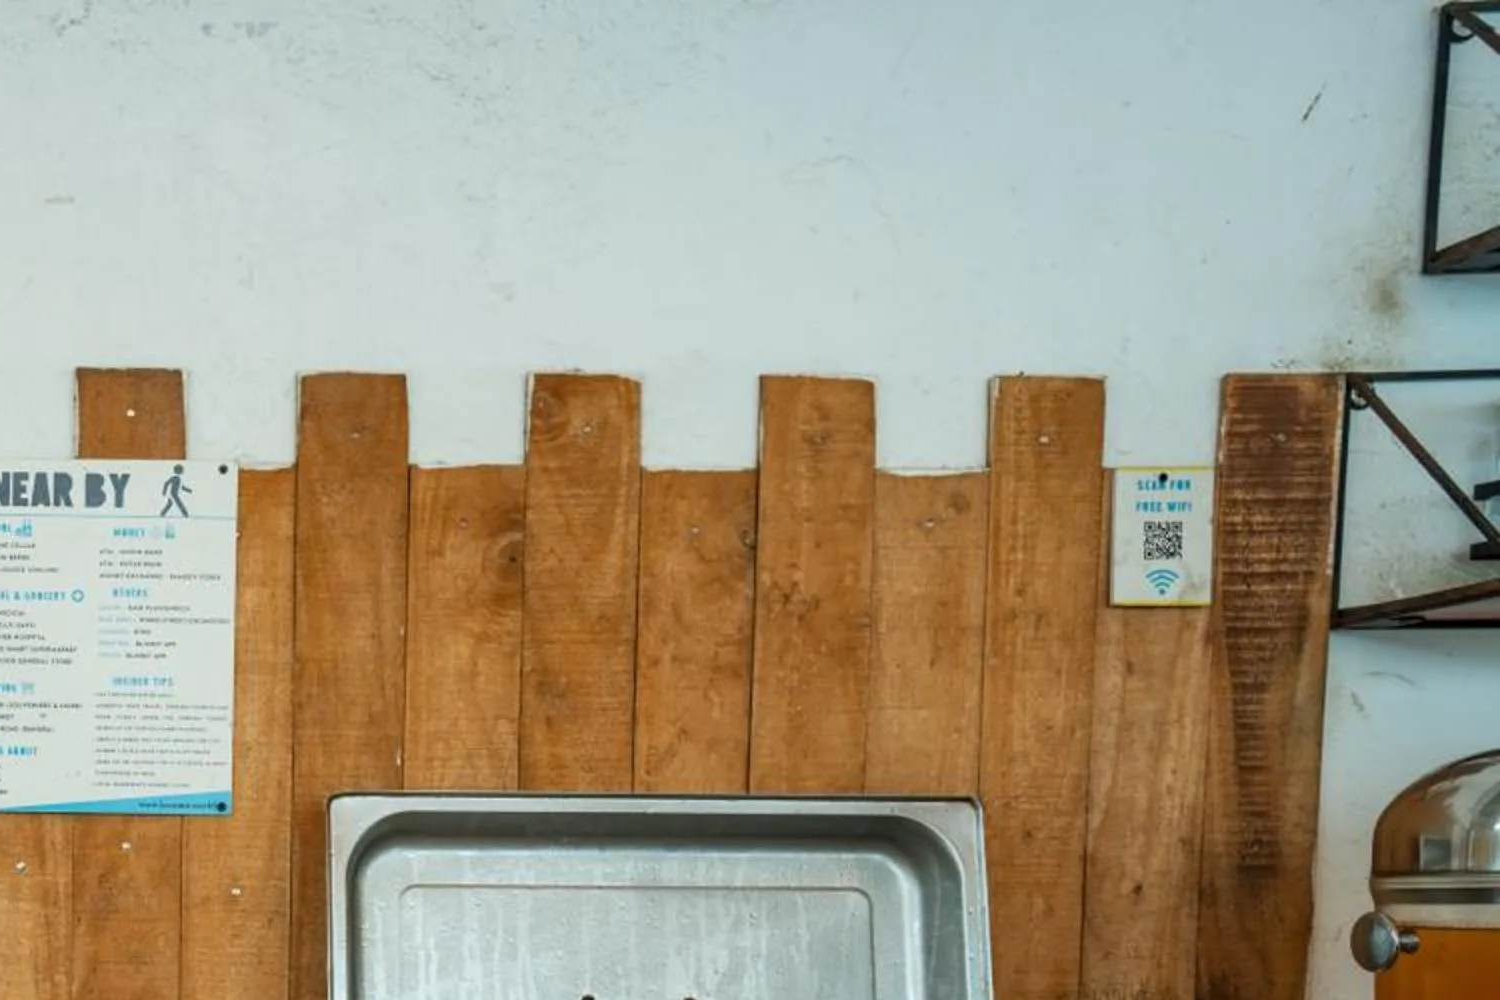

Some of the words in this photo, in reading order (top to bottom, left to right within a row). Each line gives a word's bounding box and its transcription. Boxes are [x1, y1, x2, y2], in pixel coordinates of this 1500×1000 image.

[84, 473, 131, 508] BY
[1136, 479, 1167, 491] SCAN
[1170, 479, 1191, 491] FOR
[1135, 501, 1161, 513] FREE
[1167, 501, 1193, 513] WIFI
[23, 591, 66, 601] GROCERY
[8, 746, 37, 756] ABOUT
